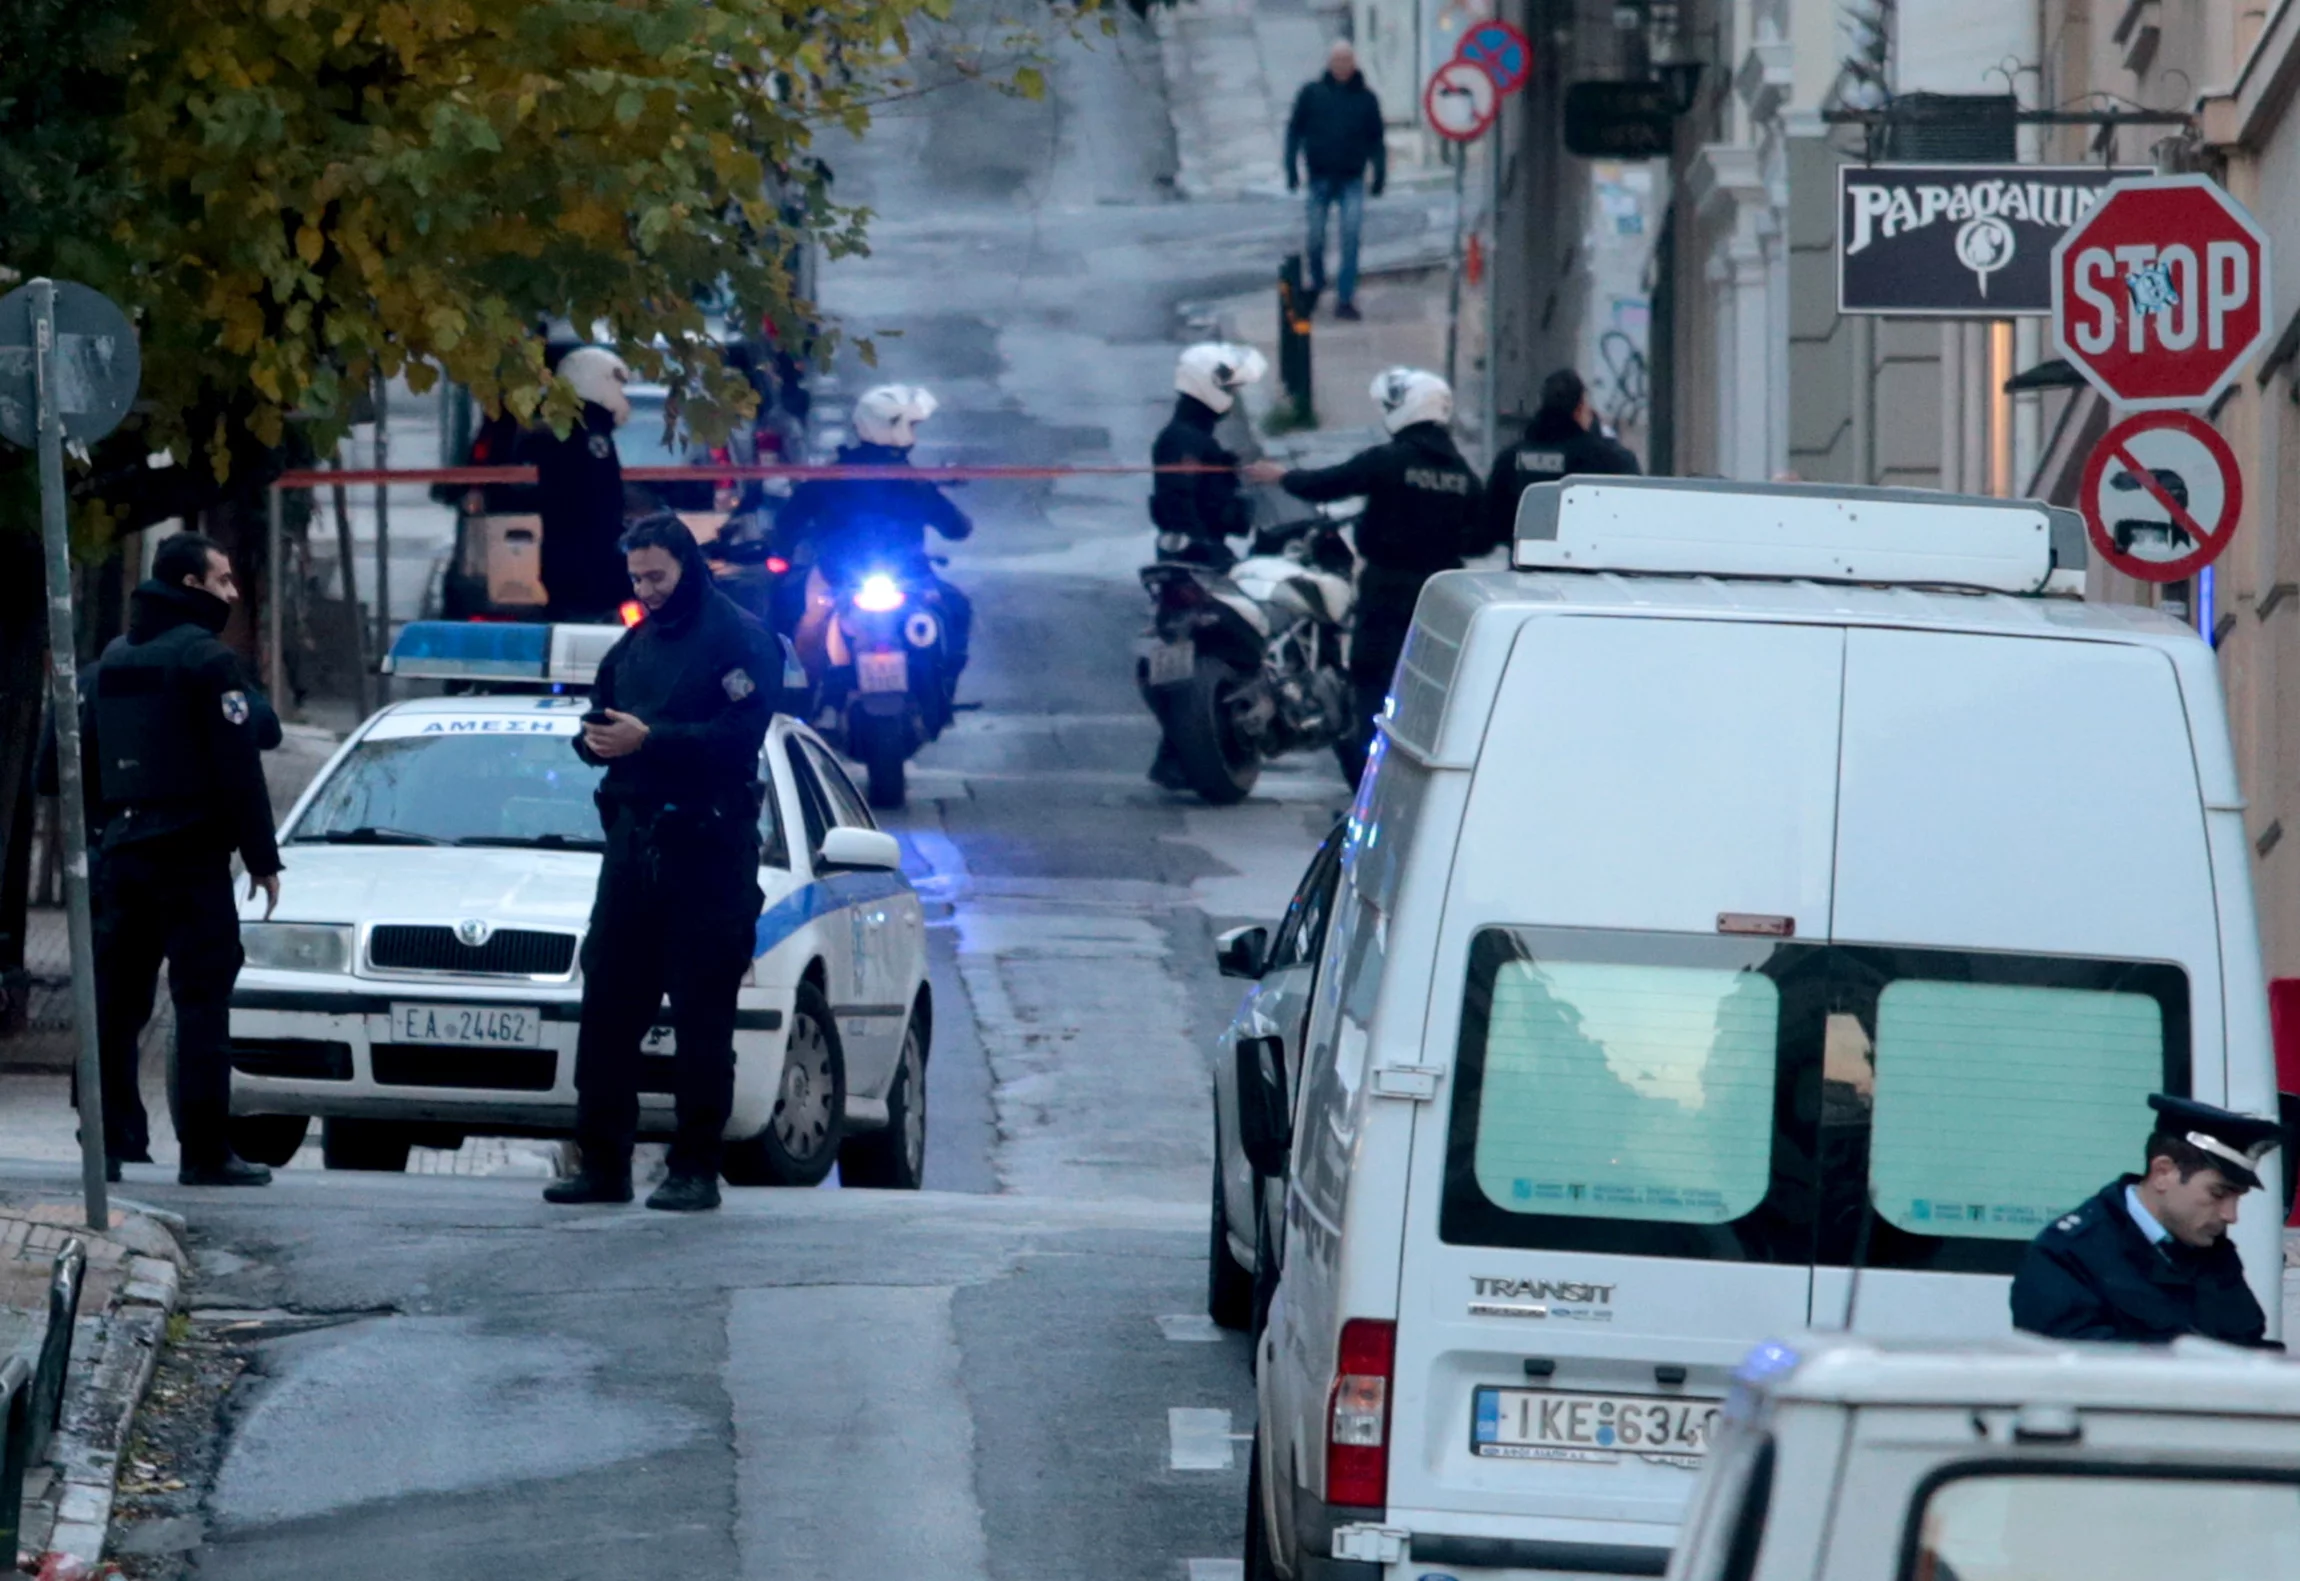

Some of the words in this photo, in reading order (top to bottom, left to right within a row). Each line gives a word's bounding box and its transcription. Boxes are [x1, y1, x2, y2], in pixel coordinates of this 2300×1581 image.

[2074, 241, 2249, 355] STOP
[1404, 466, 1468, 496] POLICE
[422, 720, 554, 733] ΑΜΕΣΗ
[459, 1012, 526, 1041] 24462
[1470, 1275, 1616, 1303] TRANSIT
